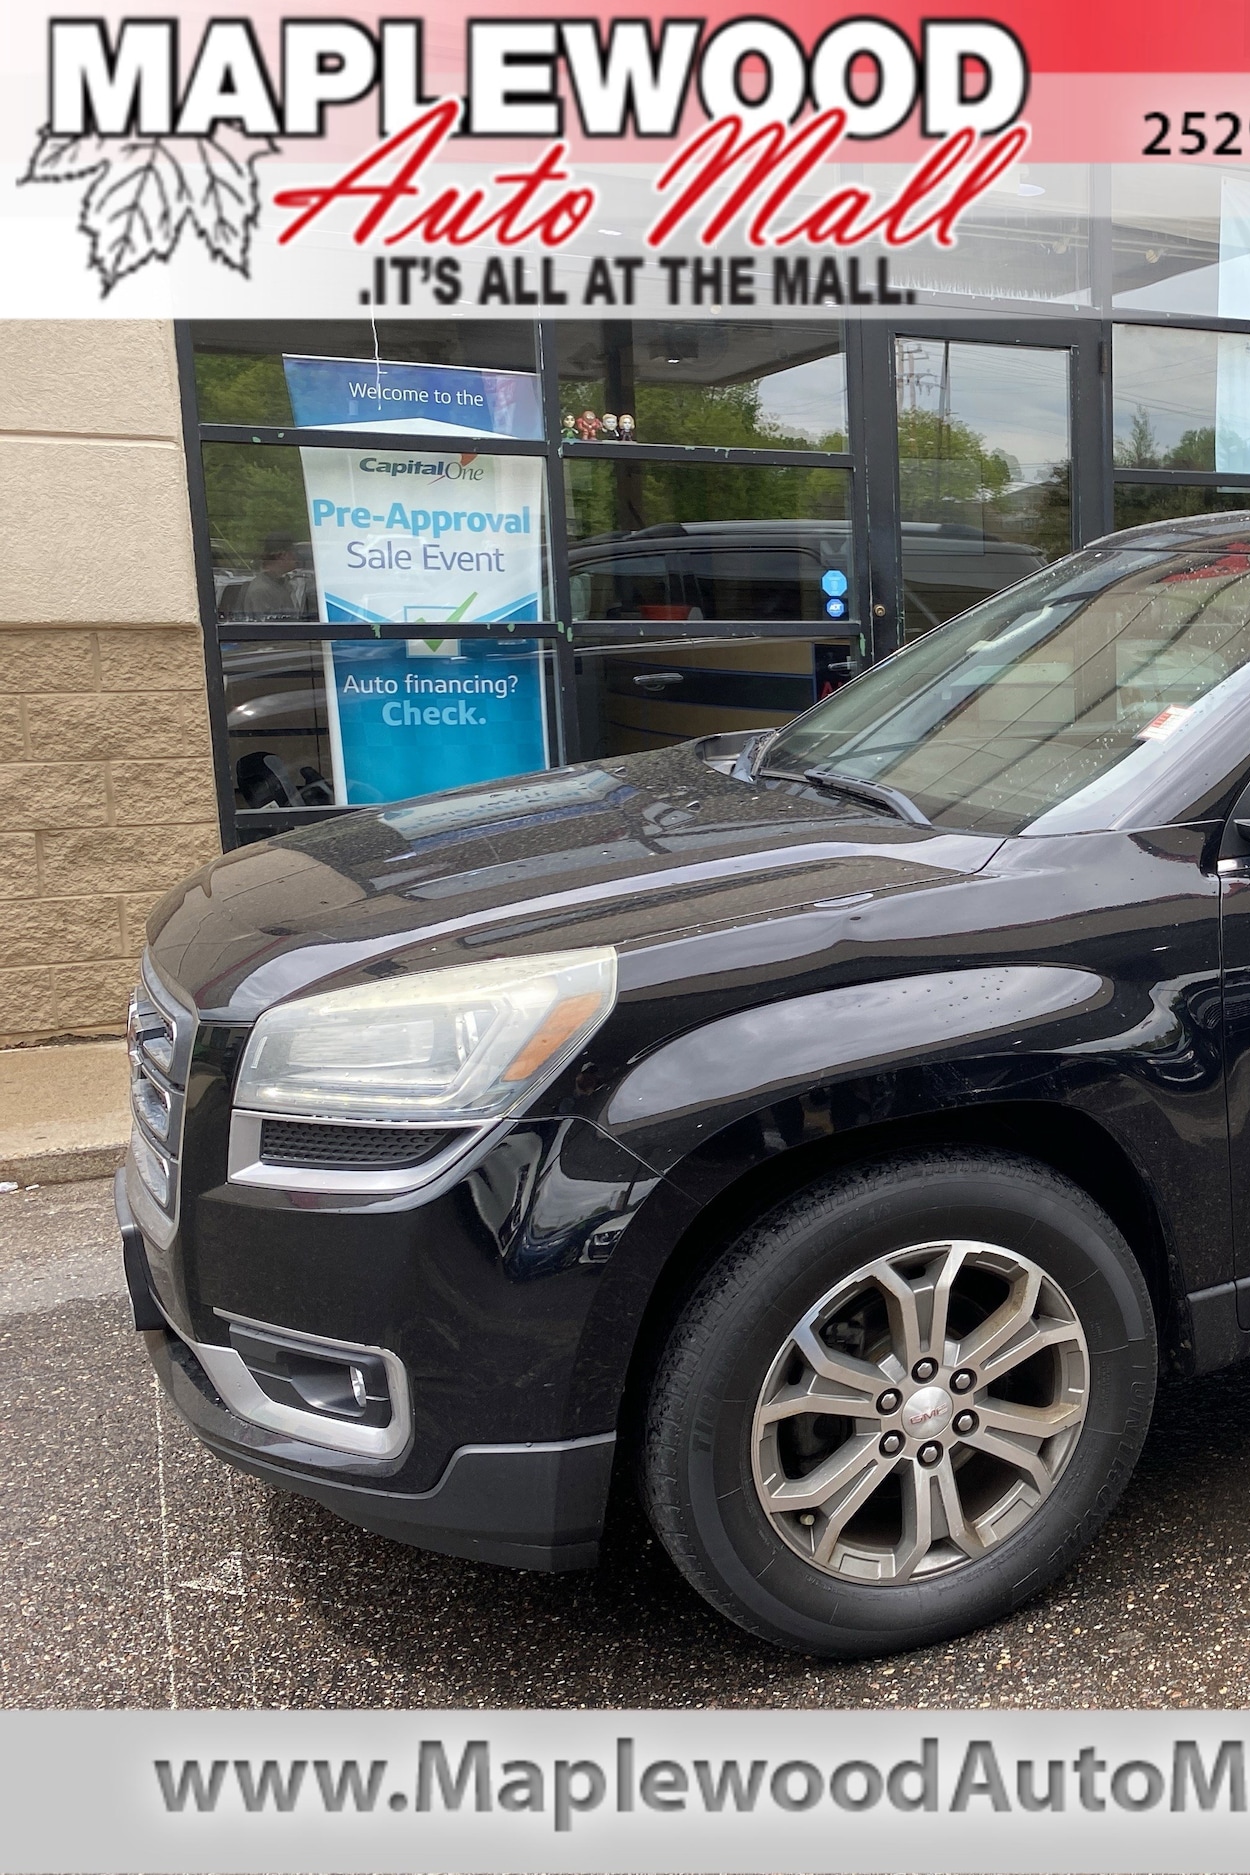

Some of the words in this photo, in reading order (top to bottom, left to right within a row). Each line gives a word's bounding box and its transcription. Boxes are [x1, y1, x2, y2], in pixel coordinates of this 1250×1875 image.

[348, 382, 429, 403] Welcome
[434, 388, 452, 405] to
[456, 390, 484, 407] the
[312, 499, 531, 539] Pre-Approval
[346, 540, 412, 570] Sale
[422, 543, 506, 572] Event
[343, 674, 398, 694] Auto
[404, 673, 519, 699] financing?
[381, 699, 487, 727] Check.
